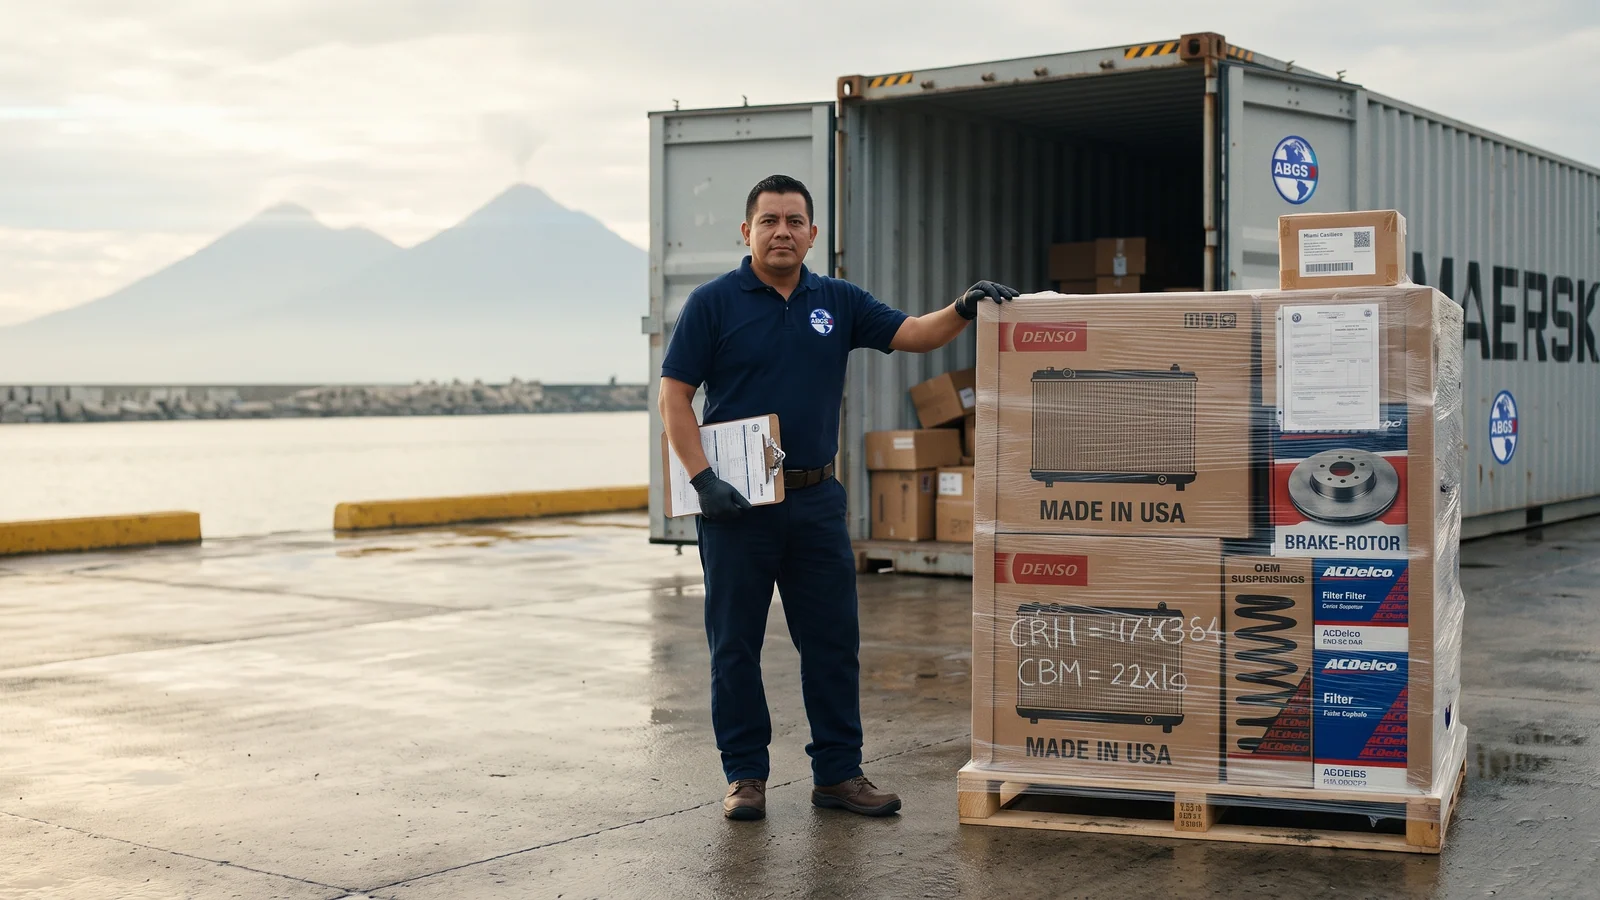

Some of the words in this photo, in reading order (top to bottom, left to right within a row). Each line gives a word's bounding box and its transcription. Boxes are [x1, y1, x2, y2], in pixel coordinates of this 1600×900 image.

[1274, 161, 1309, 178] ABGS
[1021, 330, 1077, 343] DENSO
[1491, 420, 1513, 434] ABGS
[1040, 499, 1103, 522] MADE
[1110, 500, 1132, 522] IN
[1140, 501, 1186, 523] USA
[1285, 534, 1400, 551] BRAKE-ROTOR
[1020, 562, 1078, 577] DENSO
[1254, 563, 1280, 573] OEM
[1322, 565, 1393, 578] ACDelco
[1231, 574, 1305, 584] SUSPENSINGS
[1322, 591, 1344, 600] Filter
[1345, 591, 1367, 600] Filter
[1010, 615, 1077, 650] CRH
[1322, 629, 1361, 638] ACDelco
[1324, 658, 1398, 672] ACDelco
[1018, 658, 1082, 687] CBM
[1323, 692, 1354, 705] Filter
[1026, 736, 1089, 760] MADE
[1097, 740, 1119, 762] IN
[1126, 742, 1172, 765] USA
[1258, 741, 1309, 752] ACDelco
